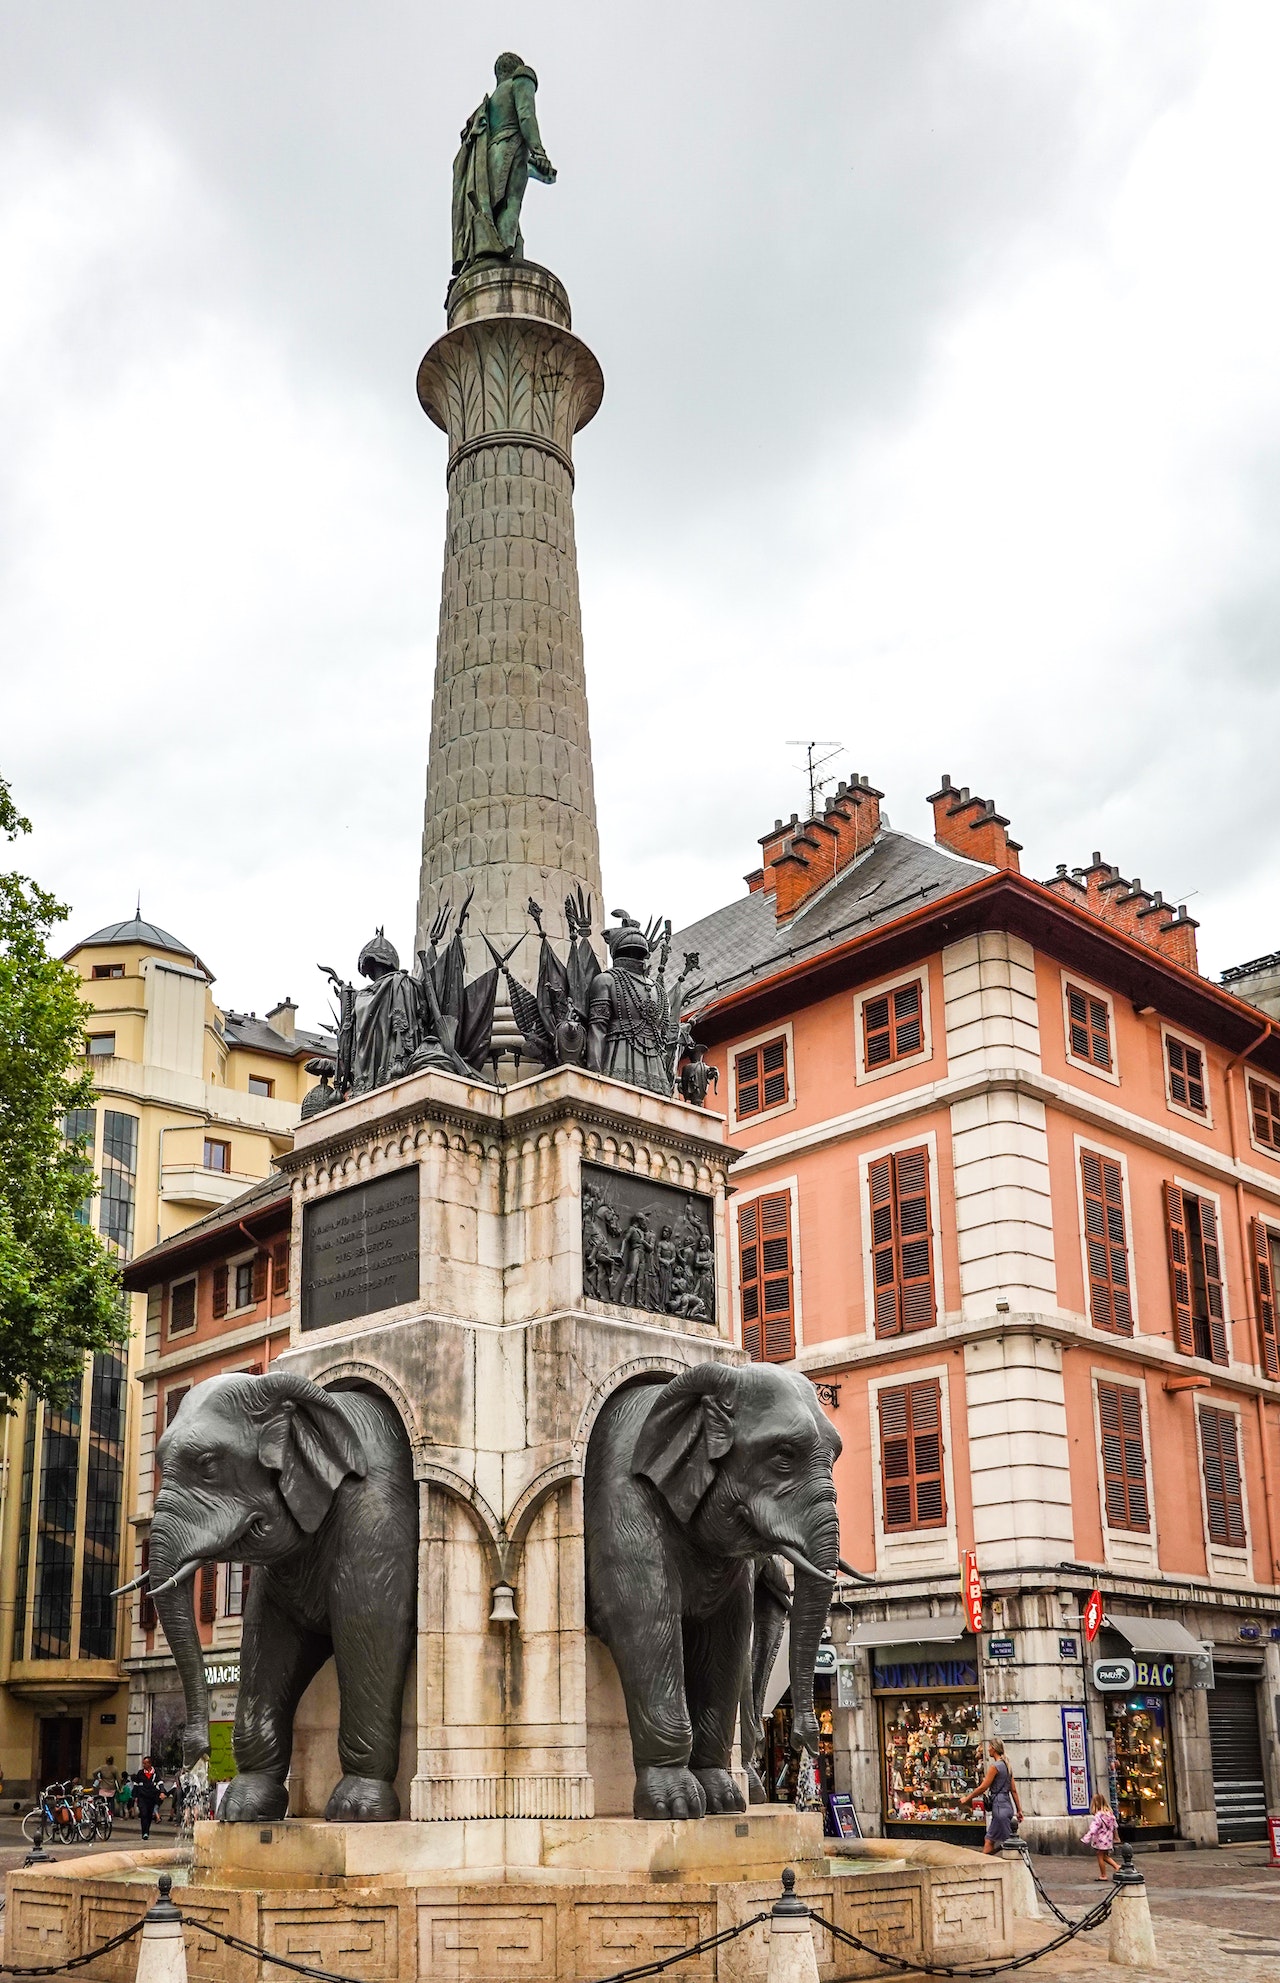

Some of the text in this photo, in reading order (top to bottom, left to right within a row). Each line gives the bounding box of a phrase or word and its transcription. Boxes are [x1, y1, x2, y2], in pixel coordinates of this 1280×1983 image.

[969, 1553, 982, 1630] TABAC
[873, 1660, 977, 1689] SOUVENIRS
[1100, 1671, 1116, 1680] PMU
[1136, 1662, 1174, 1687] BAC
